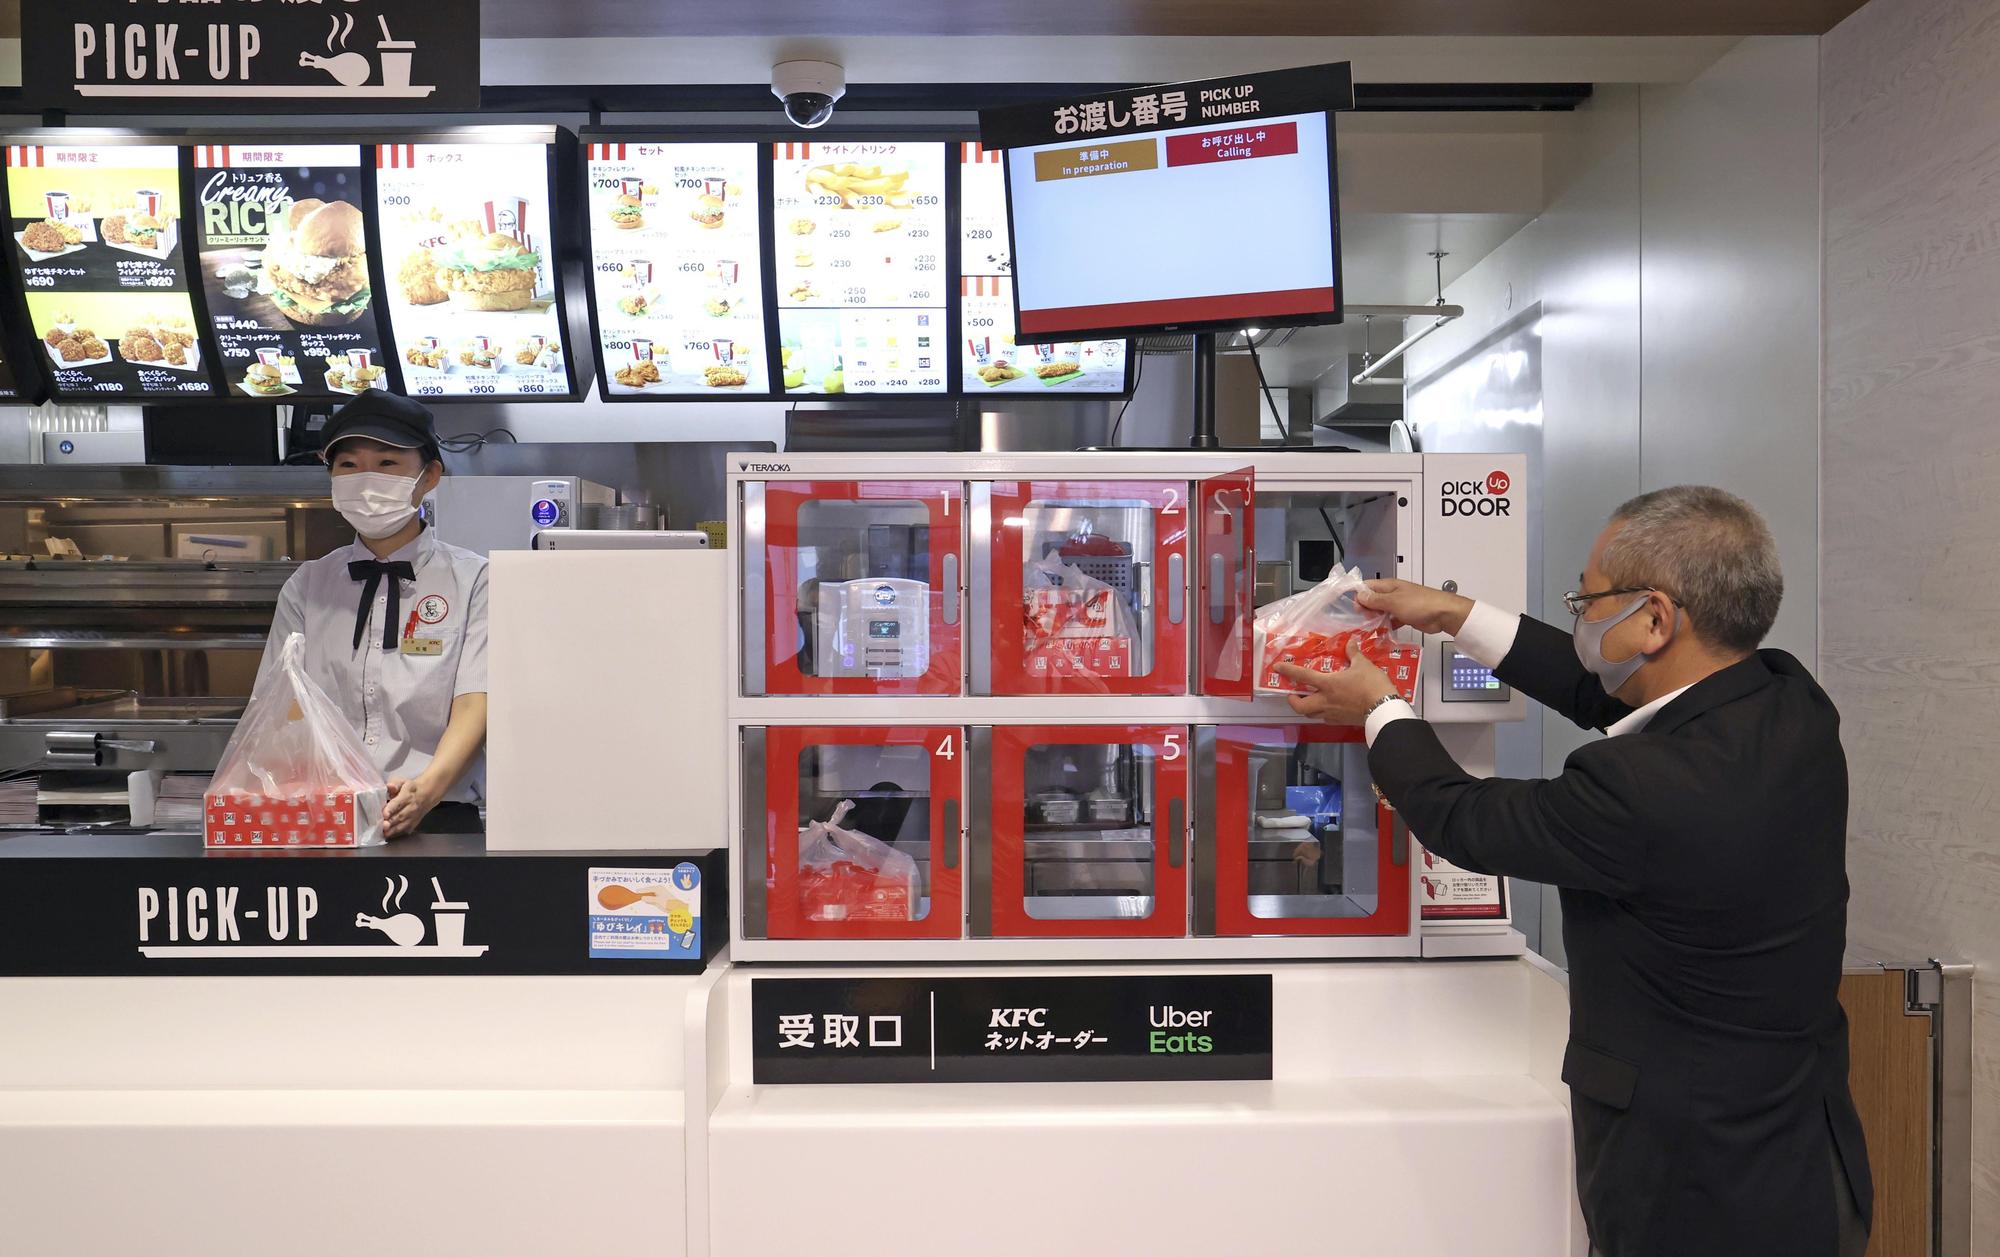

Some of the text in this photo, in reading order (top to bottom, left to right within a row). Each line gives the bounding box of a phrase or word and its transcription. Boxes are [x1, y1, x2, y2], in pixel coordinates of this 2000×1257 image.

[74, 23, 261, 80] PICK-UP
[1200, 85, 1254, 102] PICK UP
[1054, 90, 1188, 135] お渡し番号
[1202, 101, 1260, 118] NUMBER
[1201, 130, 1266, 148] お呼び出し中
[638, 145, 664, 156] セット
[1079, 149, 1110, 162] 準備中
[1217, 146, 1252, 160] Calling
[56, 152, 99, 162] 期間限定
[242, 152, 284, 162] 期間限定
[1062, 161, 1128, 176] In preparation
[232, 173, 283, 183] トリュフ香る
[593, 179, 620, 188] ¥700
[675, 179, 702, 188] ¥700
[200, 171, 294, 214] Creamy
[383, 196, 411, 205] ¥900
[813, 196, 841, 205] ¥230
[856, 195, 884, 205] ¥330
[910, 195, 938, 205] ¥650
[829, 230, 851, 238] ¥250
[908, 230, 929, 238] ¥230
[966, 230, 993, 239] ¥280
[596, 263, 623, 272] ¥660
[678, 262, 705, 272] ¥660
[26, 277, 55, 287] ¥690
[145, 276, 173, 287] ¥920
[229, 320, 258, 330] ¥440
[968, 318, 994, 327] ¥500
[604, 341, 631, 350] ¥800
[684, 342, 710, 350] ¥760
[223, 349, 251, 357] ¥750
[304, 348, 331, 357] ¥950
[94, 383, 123, 391] ¥1180
[177, 382, 209, 392] ¥1680
[417, 386, 443, 395] ¥990
[469, 385, 495, 394] ¥900
[518, 384, 544, 393] ¥860
[750, 463, 791, 472] TERAOKA
[940, 490, 949, 516] 1
[1160, 488, 1179, 515] 2
[1441, 498, 1510, 516] DOOR
[935, 734, 954, 760] 4
[1162, 734, 1180, 761] 5
[138, 886, 318, 942] PICK-UP
[989, 1007, 1049, 1028] KFC
[1149, 1005, 1212, 1028] Uber
[778, 1013, 902, 1049] 受取口
[984, 1030, 1108, 1050] ネットオーダー
[1150, 1031, 1213, 1053] Eats
